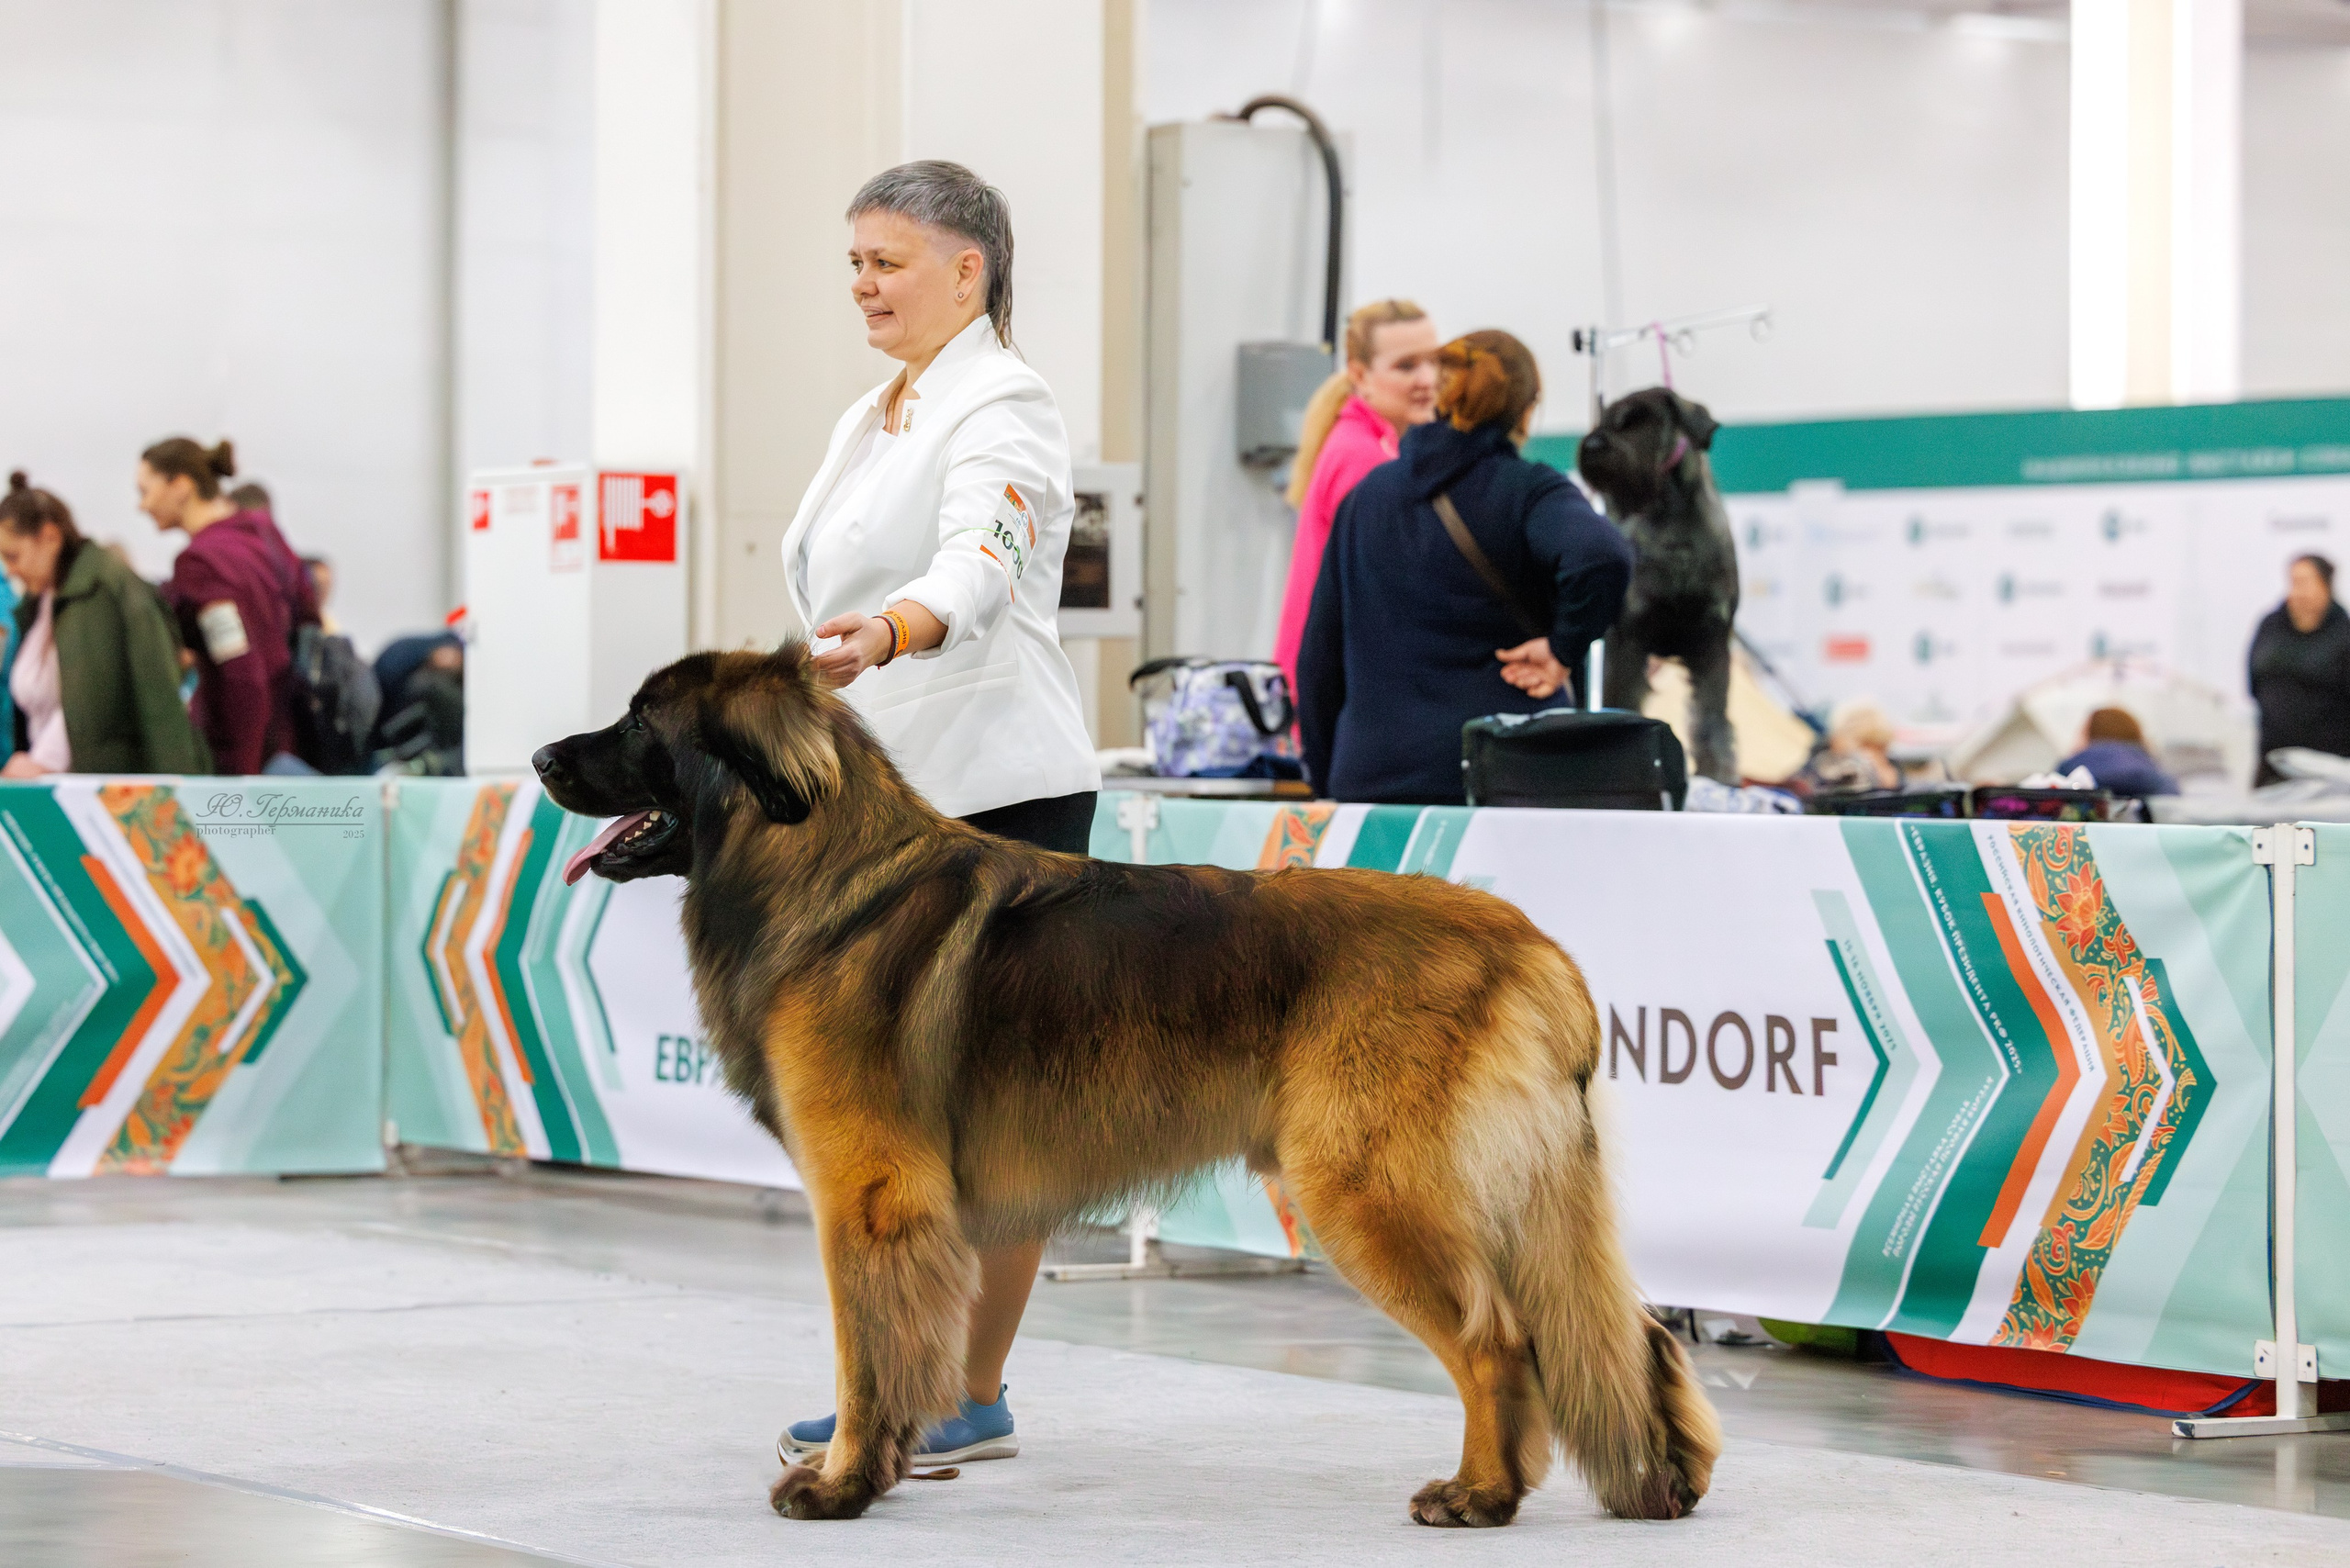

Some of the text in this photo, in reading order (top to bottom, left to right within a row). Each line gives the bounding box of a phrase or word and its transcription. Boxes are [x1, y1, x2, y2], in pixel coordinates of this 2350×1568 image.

[993, 519, 1024, 580] 1000
[1934, 887, 1956, 931] КУБОК
[1952, 928, 1991, 1012] ПРЕЗИДЕНТА
[1986, 834, 2097, 1073] РОССИЙСКАЯ КИНОЛОГИЧЕСКАЯ ФЕДЕРАЦИЯ
[655, 1033, 711, 1084] ЕВР
[1609, 1002, 1838, 1097] NDORF
